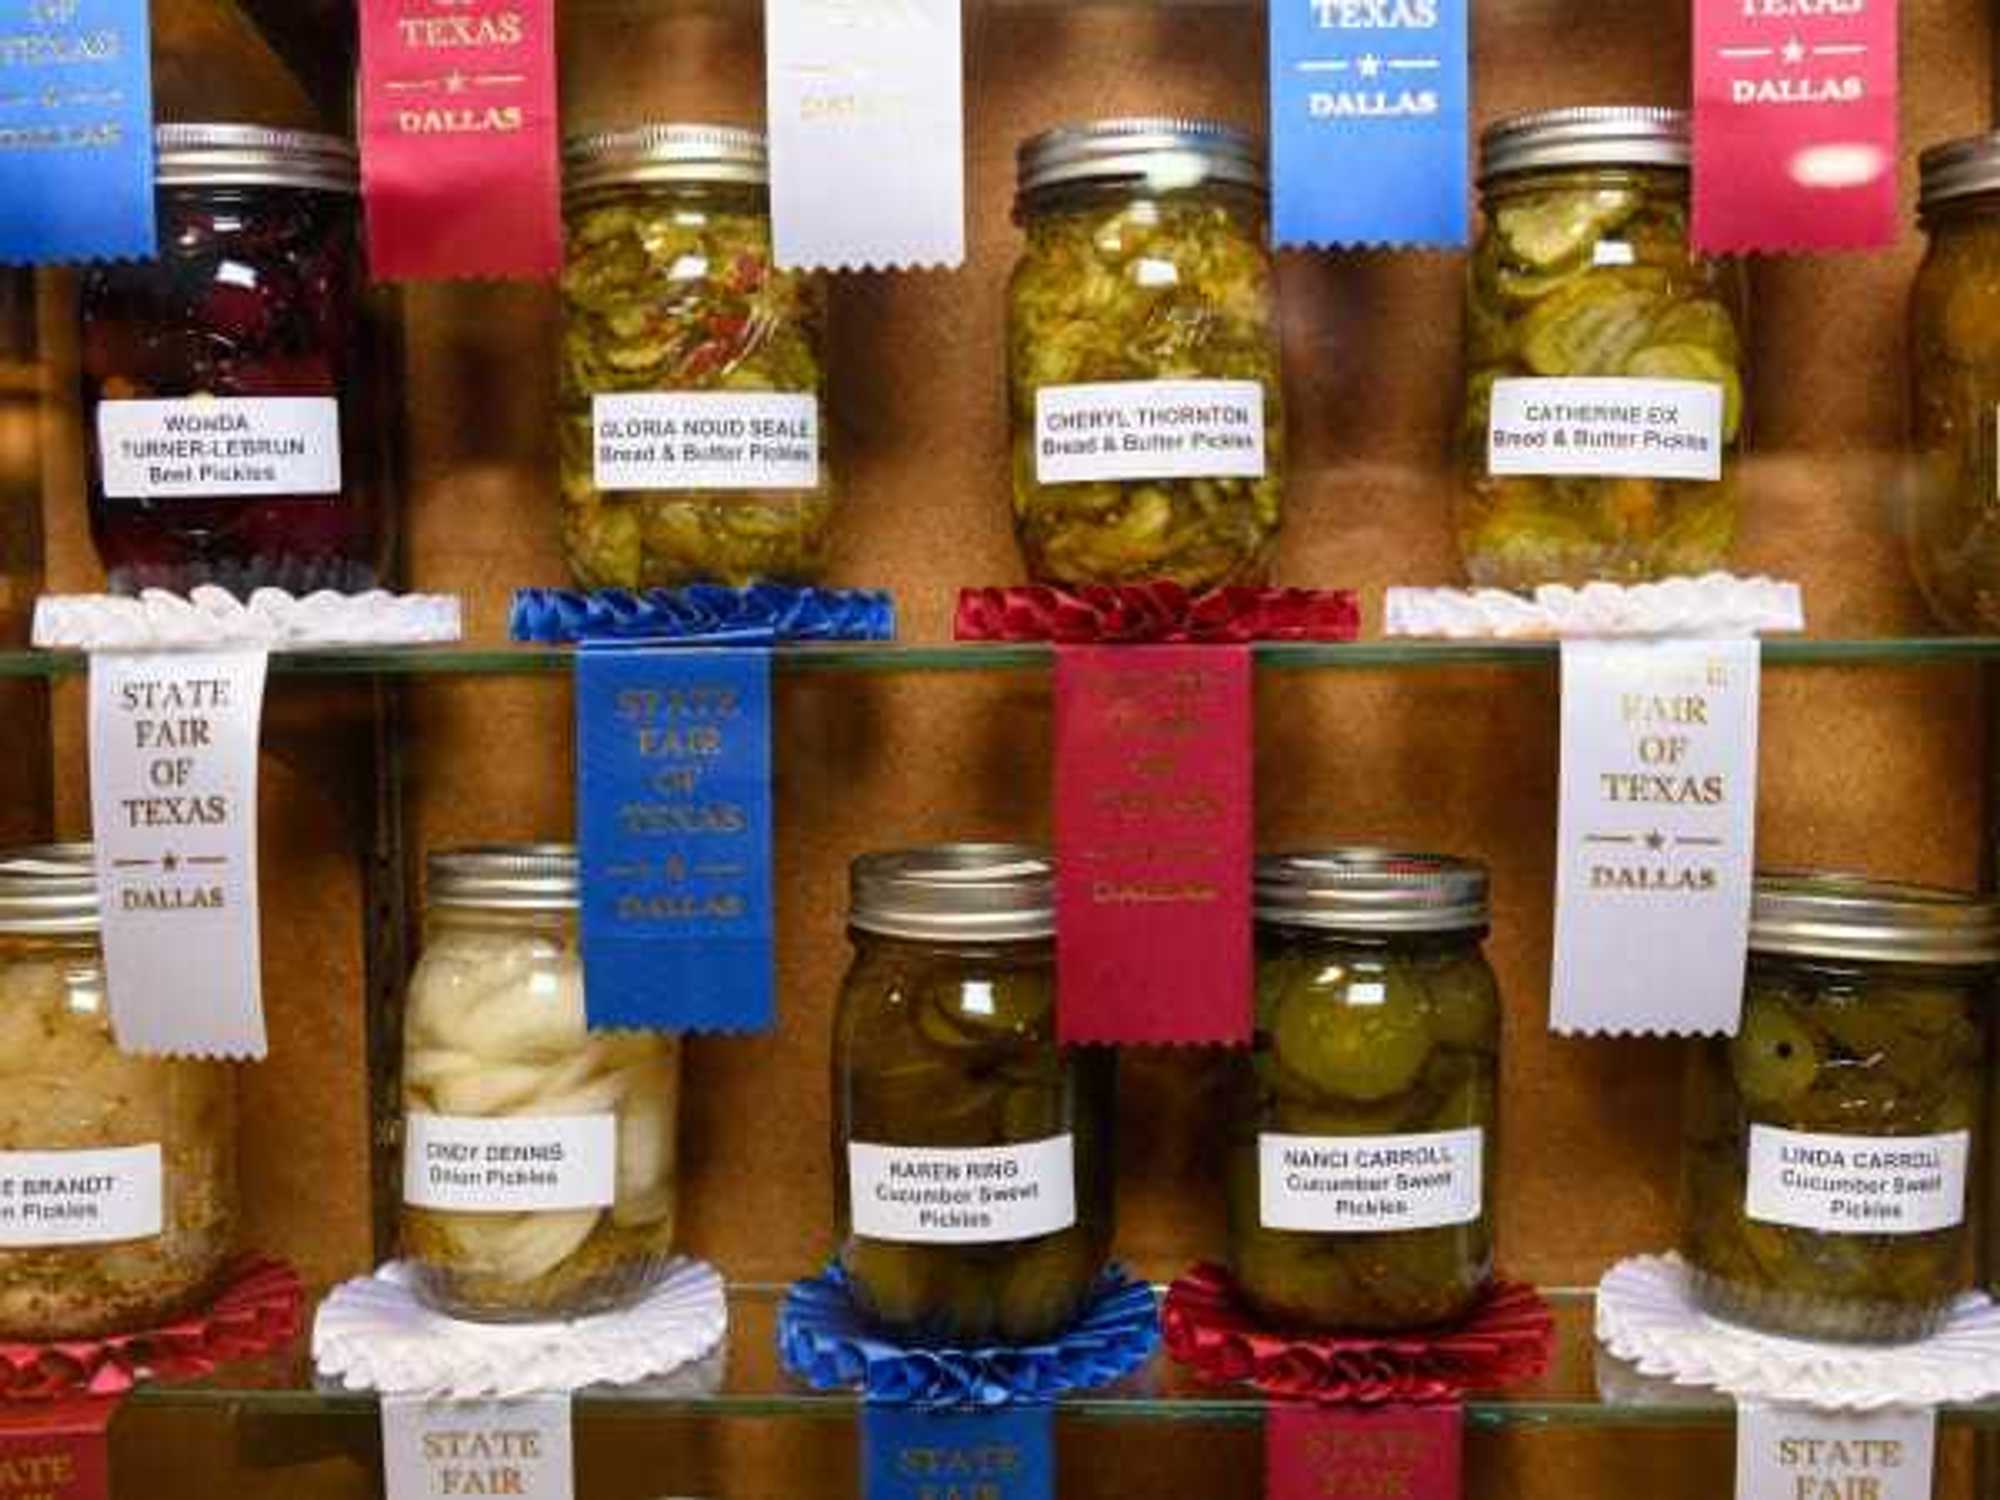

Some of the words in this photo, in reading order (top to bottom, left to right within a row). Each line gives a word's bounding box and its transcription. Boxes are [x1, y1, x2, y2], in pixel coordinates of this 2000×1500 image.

[1308, 0, 1437, 28] TEXAS
[399, 13, 520, 47] TEXAS
[1733, 77, 1863, 104] DALLAS
[1309, 91, 1437, 118] DALLAS
[400, 106, 520, 132] DALLAS
[163, 412, 249, 432] WONDA
[1046, 410, 1130, 431] CHERYL
[1137, 404, 1249, 427] THORNTON
[1526, 405, 1642, 424] CATHERINE
[600, 418, 676, 439] GLORIA
[1493, 429, 1546, 448] Bread
[1553, 428, 1567, 447] &
[1573, 429, 1636, 449] Butter
[1642, 430, 1709, 452] Pickles
[600, 441, 655, 462] Bread
[662, 442, 676, 461] &
[682, 442, 744, 462] Butter
[749, 442, 813, 462] Pickles
[1042, 436, 1097, 456] Bread
[1102, 434, 1117, 454] &
[1123, 433, 1185, 453] Butter
[1190, 430, 1255, 450] Pickles
[200, 463, 277, 482] Pickles
[121, 680, 231, 710] STATE
[135, 720, 211, 748] FAIR
[1638, 736, 1690, 765] OF
[149, 758, 194, 787] OF
[1600, 773, 1724, 804] TEXAS
[121, 798, 226, 828] TEXAS
[1591, 866, 1717, 891] DALLAS
[122, 886, 225, 910] DALLAS
[486, 1143, 564, 1162] DENNIS
[1285, 1149, 1348, 1169] NANCI
[1355, 1146, 1451, 1168] CARROLL
[1781, 1146, 1844, 1168] LINDA
[429, 1164, 481, 1185] Onion
[486, 1168, 558, 1186] Pickles
[889, 1160, 960, 1181] KAREN
[966, 1159, 1018, 1179] RING
[1286, 1174, 1389, 1192] Cucumber
[1396, 1171, 1452, 1191] Sweet
[1782, 1169, 1891, 1195] Cucumber
[1893, 1173, 1942, 1194] Sweet
[23, 1176, 114, 1196] BRANDT
[875, 1182, 973, 1204] Cucumber
[979, 1181, 1040, 1201] Sweet
[22, 1202, 99, 1220] Pickles
[919, 1208, 992, 1228] Pickles
[1335, 1199, 1408, 1218] Pickles
[1829, 1198, 1903, 1219] Pickles
[422, 1430, 541, 1459] STATE
[1776, 1438, 1904, 1467] STATE
[440, 1466, 525, 1495] FAIR
[1796, 1474, 1883, 1500] FAIR
